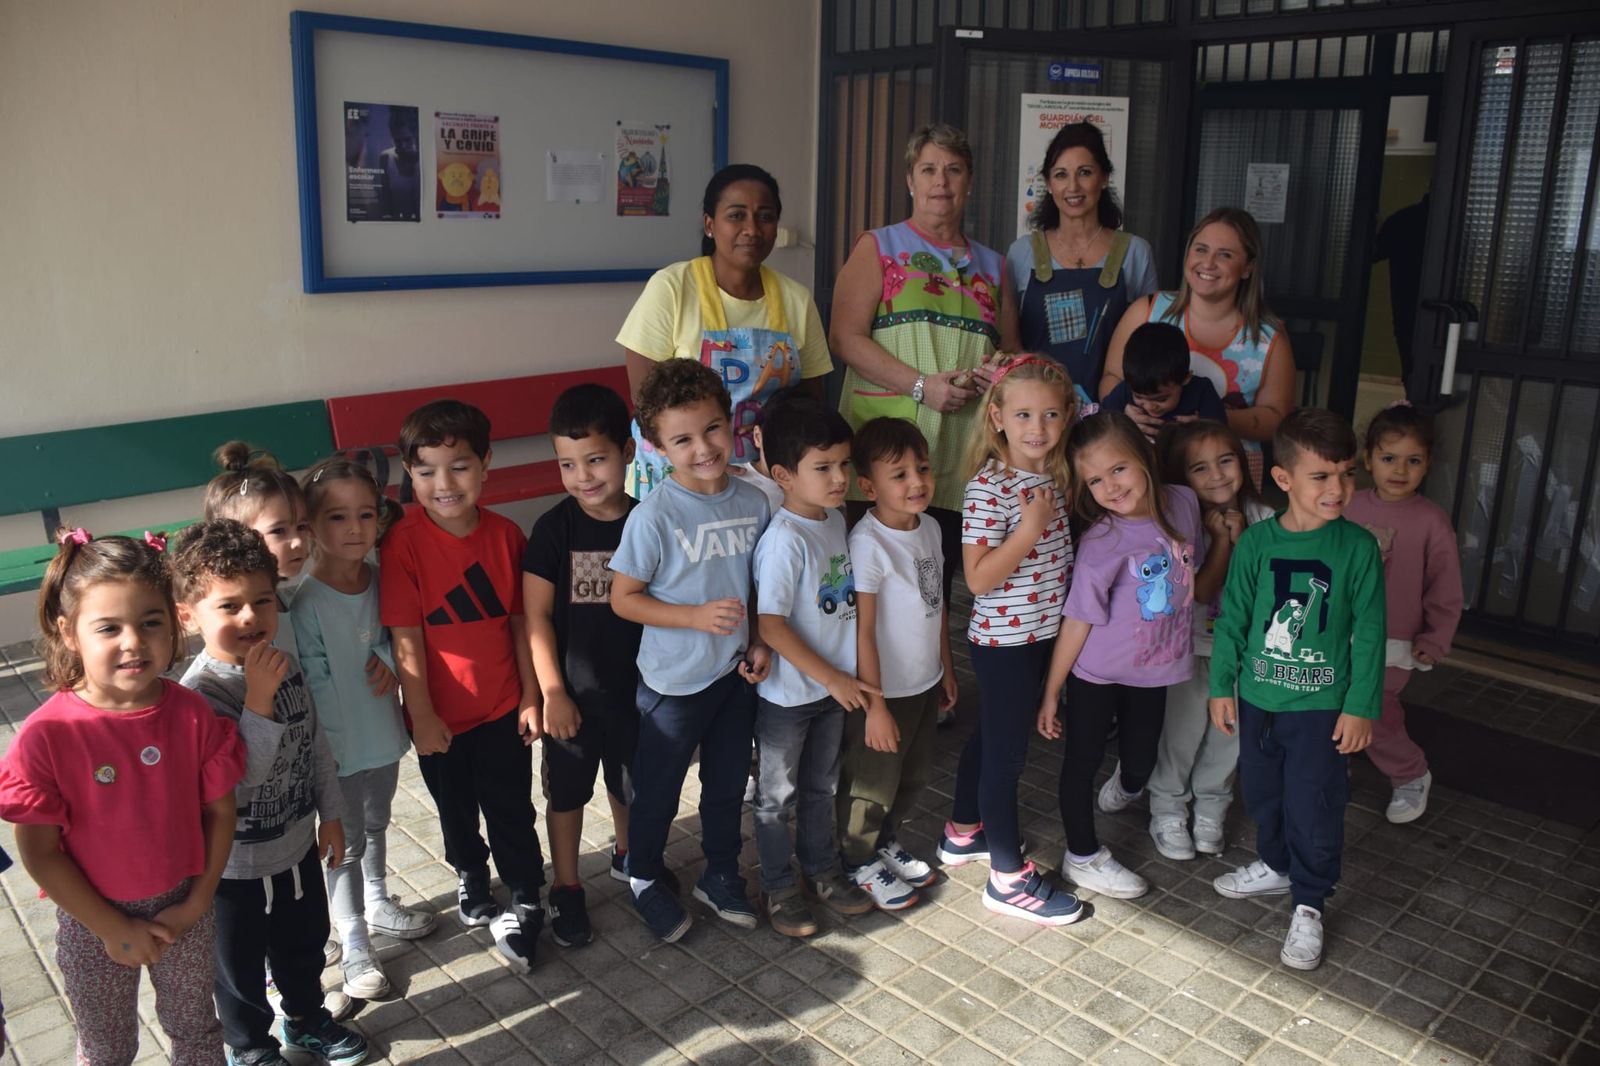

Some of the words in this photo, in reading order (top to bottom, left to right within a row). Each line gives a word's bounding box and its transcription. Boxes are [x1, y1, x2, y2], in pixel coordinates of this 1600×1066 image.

[440, 128, 456, 139] LA
[462, 129, 497, 141] GRIPE
[444, 139, 451, 150] Y
[456, 140, 494, 152] COVID
[674, 517, 759, 563] VANS
[1273, 663, 1334, 685] BEARS
[1283, 681, 1299, 691] YOUR
